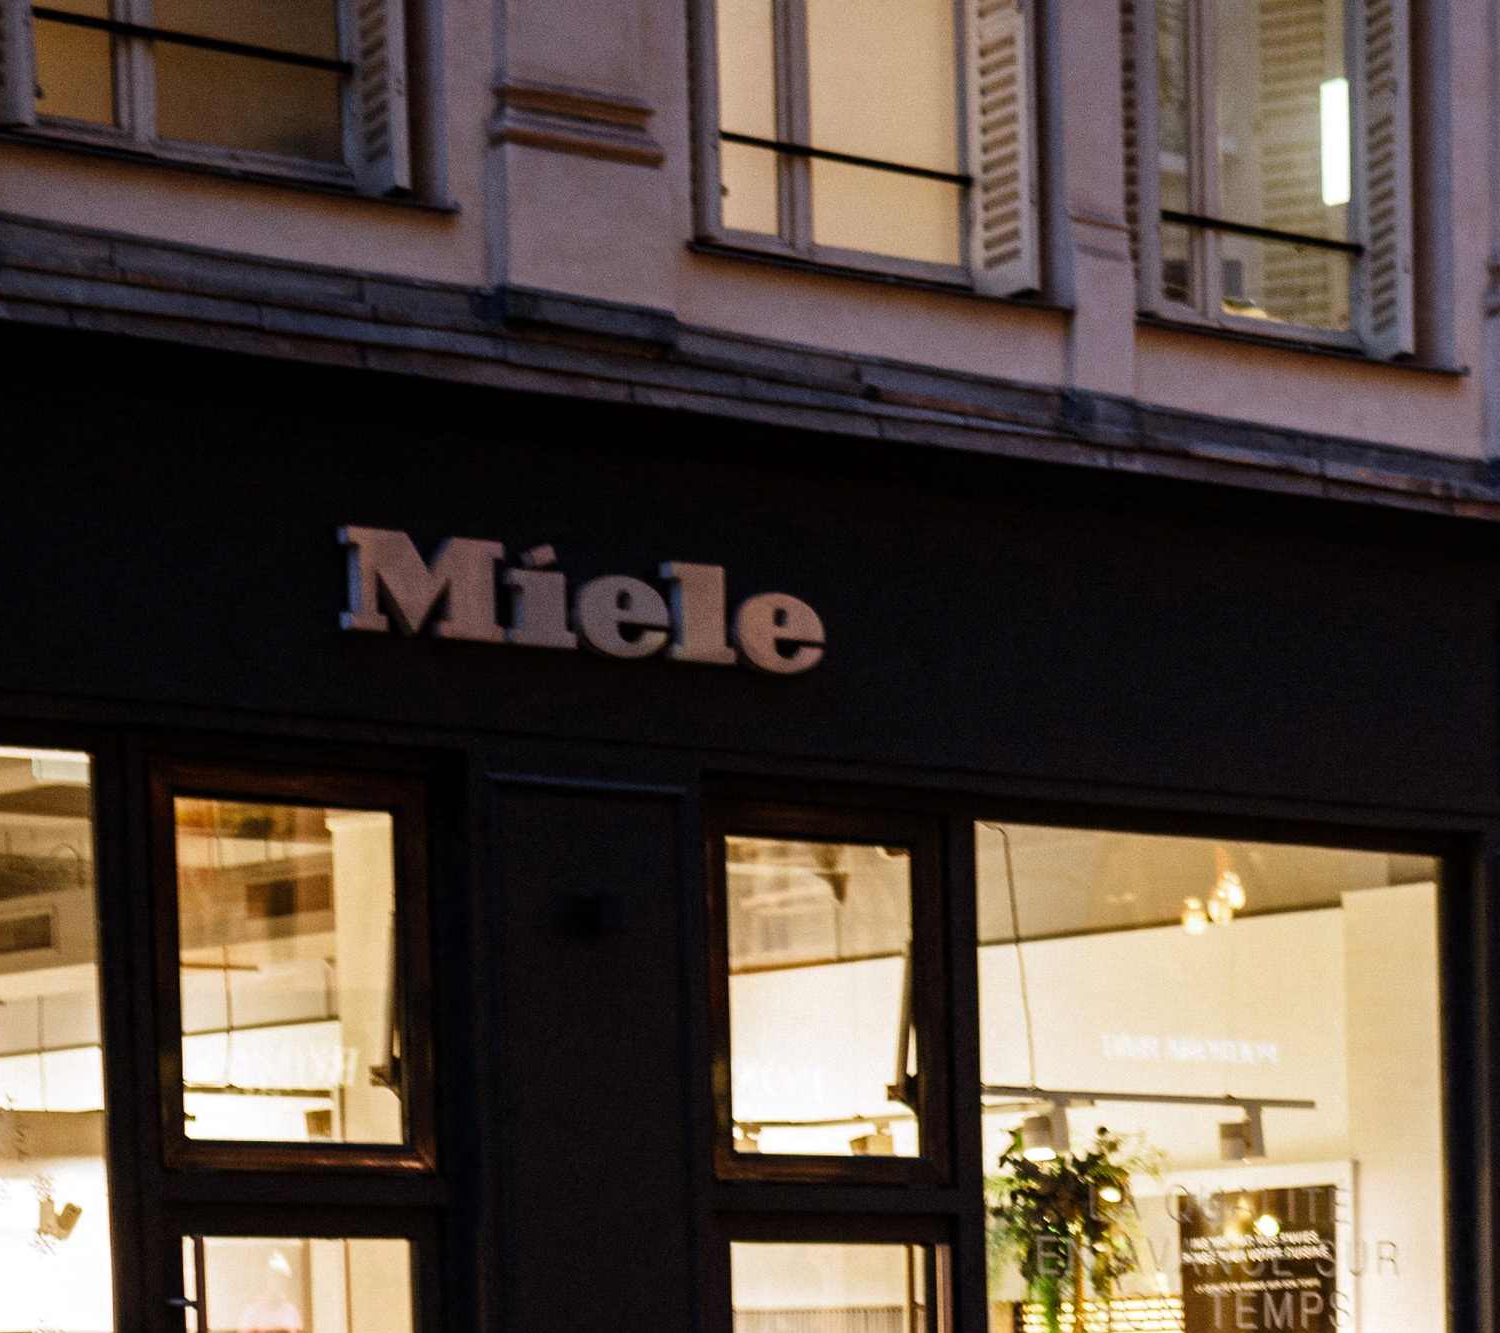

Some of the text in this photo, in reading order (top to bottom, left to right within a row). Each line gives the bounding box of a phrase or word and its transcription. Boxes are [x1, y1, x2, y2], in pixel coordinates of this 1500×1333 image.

[337, 525, 826, 675] Miele
[1314, 1237, 1400, 1279] SUR
[1211, 1288, 1352, 1331] TEMPS
